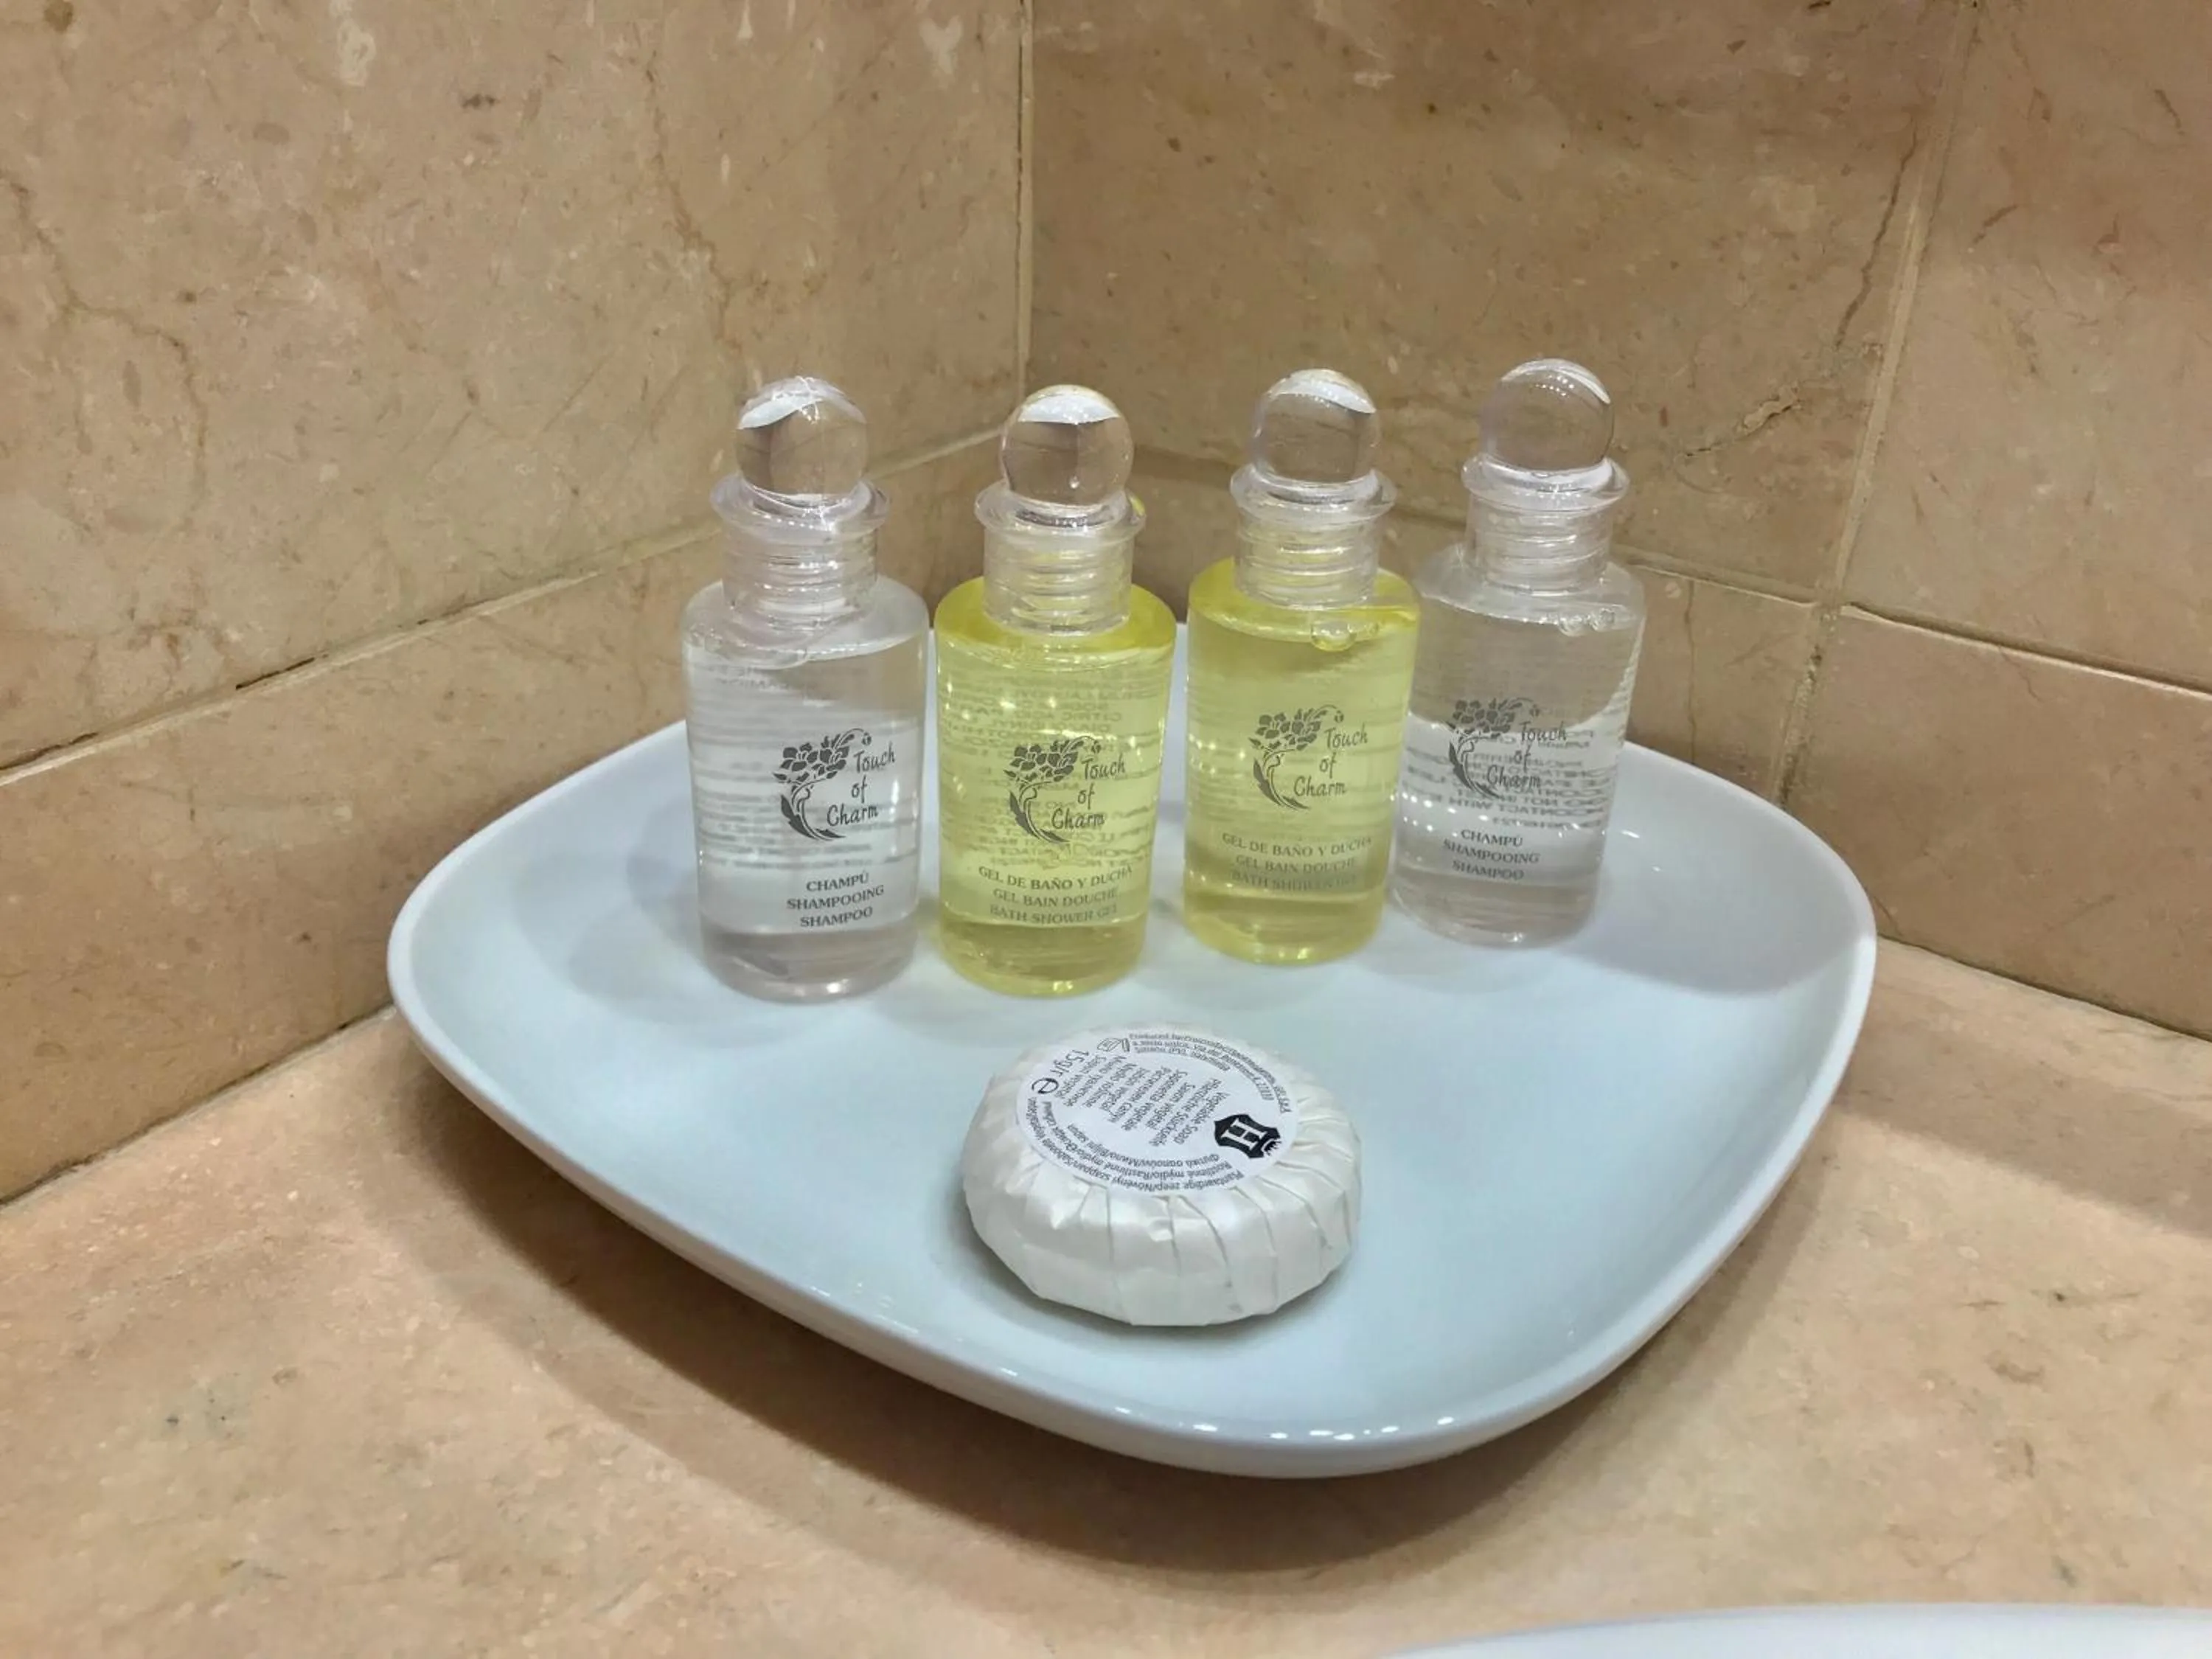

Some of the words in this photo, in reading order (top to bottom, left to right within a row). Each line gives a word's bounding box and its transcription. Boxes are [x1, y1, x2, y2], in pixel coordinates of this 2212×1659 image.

[1324, 723, 1368, 750] Touch
[1519, 720, 1568, 742] Touch
[854, 741, 896, 773] Touch
[1080, 753, 1126, 780] Touch
[1319, 751, 1337, 779] of
[1514, 747, 1531, 773] of
[1293, 776, 1346, 798] Charm
[1486, 764, 1542, 788] Charm
[851, 775, 868, 804] of
[1077, 782, 1095, 810] of
[826, 803, 880, 827] Charm
[1051, 807, 1105, 830] Charm
[1222, 832, 1247, 848] GEL
[1250, 841, 1267, 854] DE
[1273, 844, 1313, 857] BAÑO
[1318, 846, 1327, 856] Y
[1461, 829, 1523, 847] CHAMPÚ
[1236, 855, 1259, 869] GEL
[1443, 838, 1541, 863] SHAMPOOING
[806, 870, 869, 892] CHAMPÚ
[978, 866, 1003, 883] GEL
[1007, 874, 1026, 888] DE
[1031, 877, 1073, 890] BAÑO
[1077, 878, 1087, 888] Y
[1091, 863, 1133, 884] DUCHA
[1453, 860, 1526, 880] SHAMPOO
[786, 885, 885, 910] SHAMPOOING
[993, 888, 1020, 903] GEL
[1023, 895, 1058, 907] BAIN
[1062, 888, 1118, 907] DOUCHE
[800, 906, 874, 928] SHAMPOO
[990, 905, 1027, 922] BATH
[1032, 910, 1093, 925] SHOWER
[1150, 1069, 1189, 1102] Saponetta
[1169, 1082, 1196, 1102] Savon
[1121, 1102, 1155, 1131] vegetale
[1190, 1092, 1231, 1124] Vegetable
[1173, 1124, 1198, 1145] Soap
